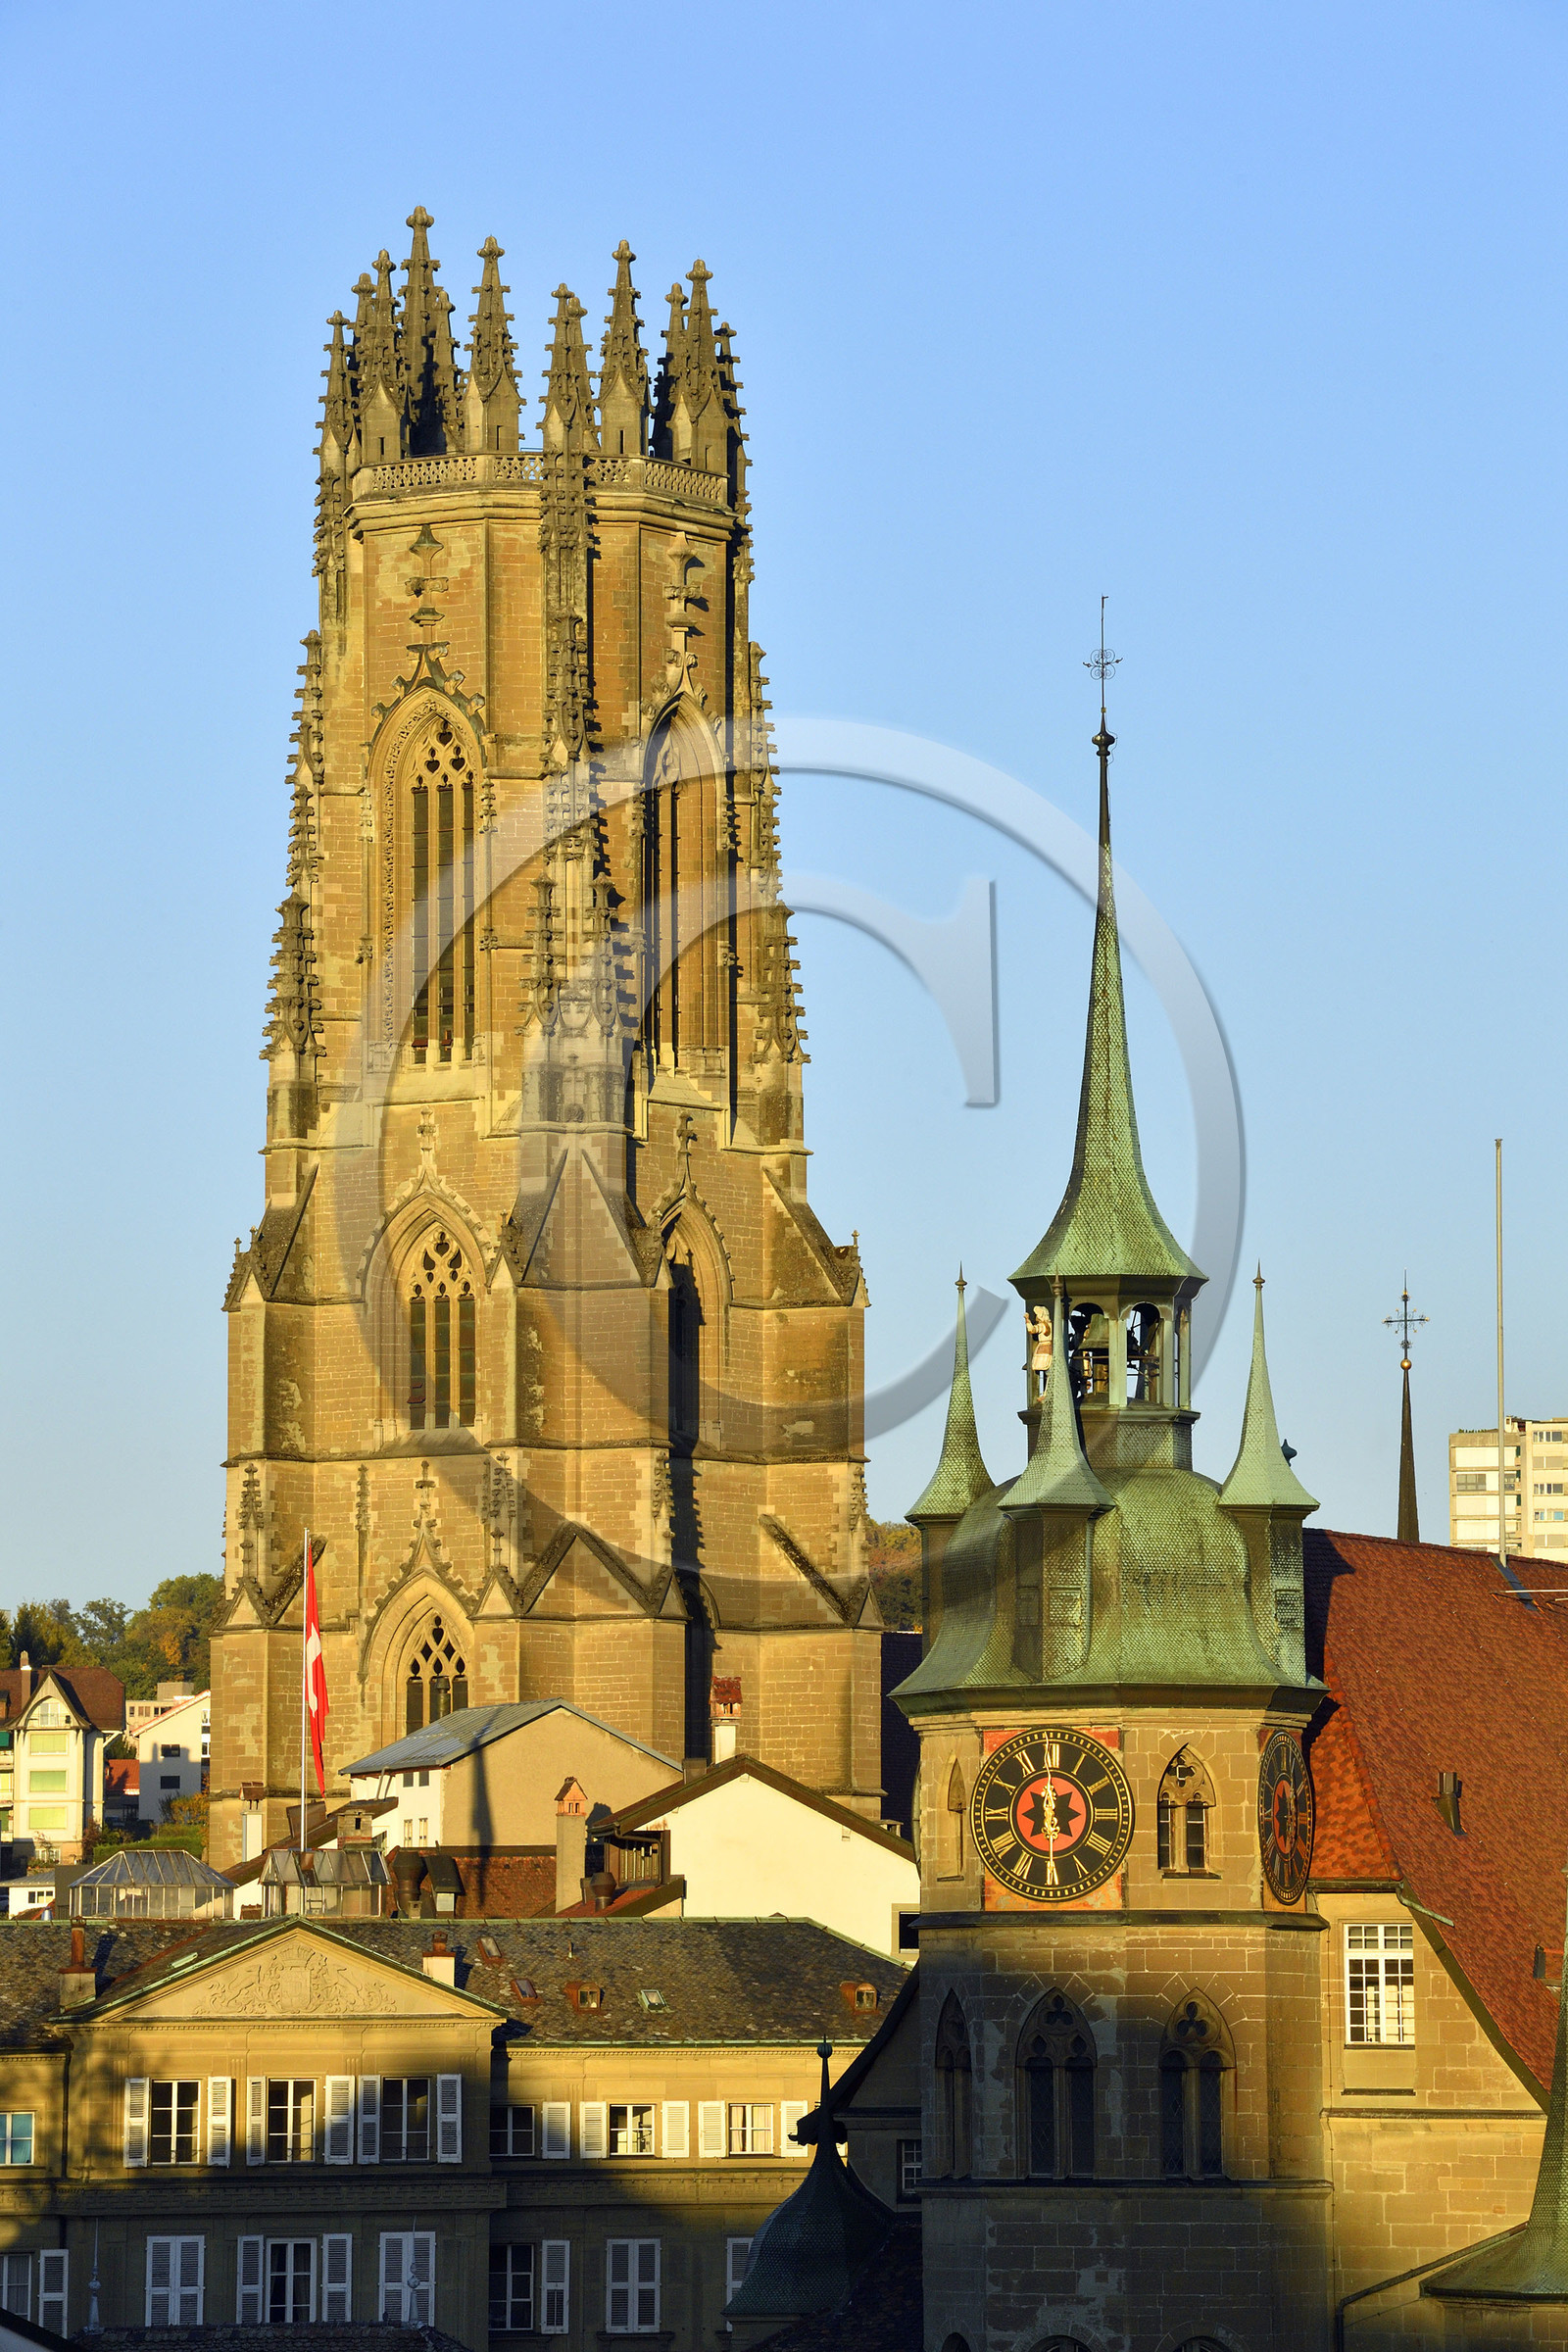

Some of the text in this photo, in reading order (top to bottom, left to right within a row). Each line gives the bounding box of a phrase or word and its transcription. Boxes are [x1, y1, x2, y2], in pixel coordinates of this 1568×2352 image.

[1014, 1750, 1036, 1778] XI
[1071, 1752, 1087, 1775] I
[992, 1775, 1016, 1795] X
[985, 1806, 1008, 1822] IX
[1094, 1807, 1118, 1822] III
[991, 1831, 1017, 1859] VIII
[1085, 1831, 1113, 1857] IIII
[1011, 1849, 1033, 1880] VII
[1073, 1854, 1089, 1879] V
